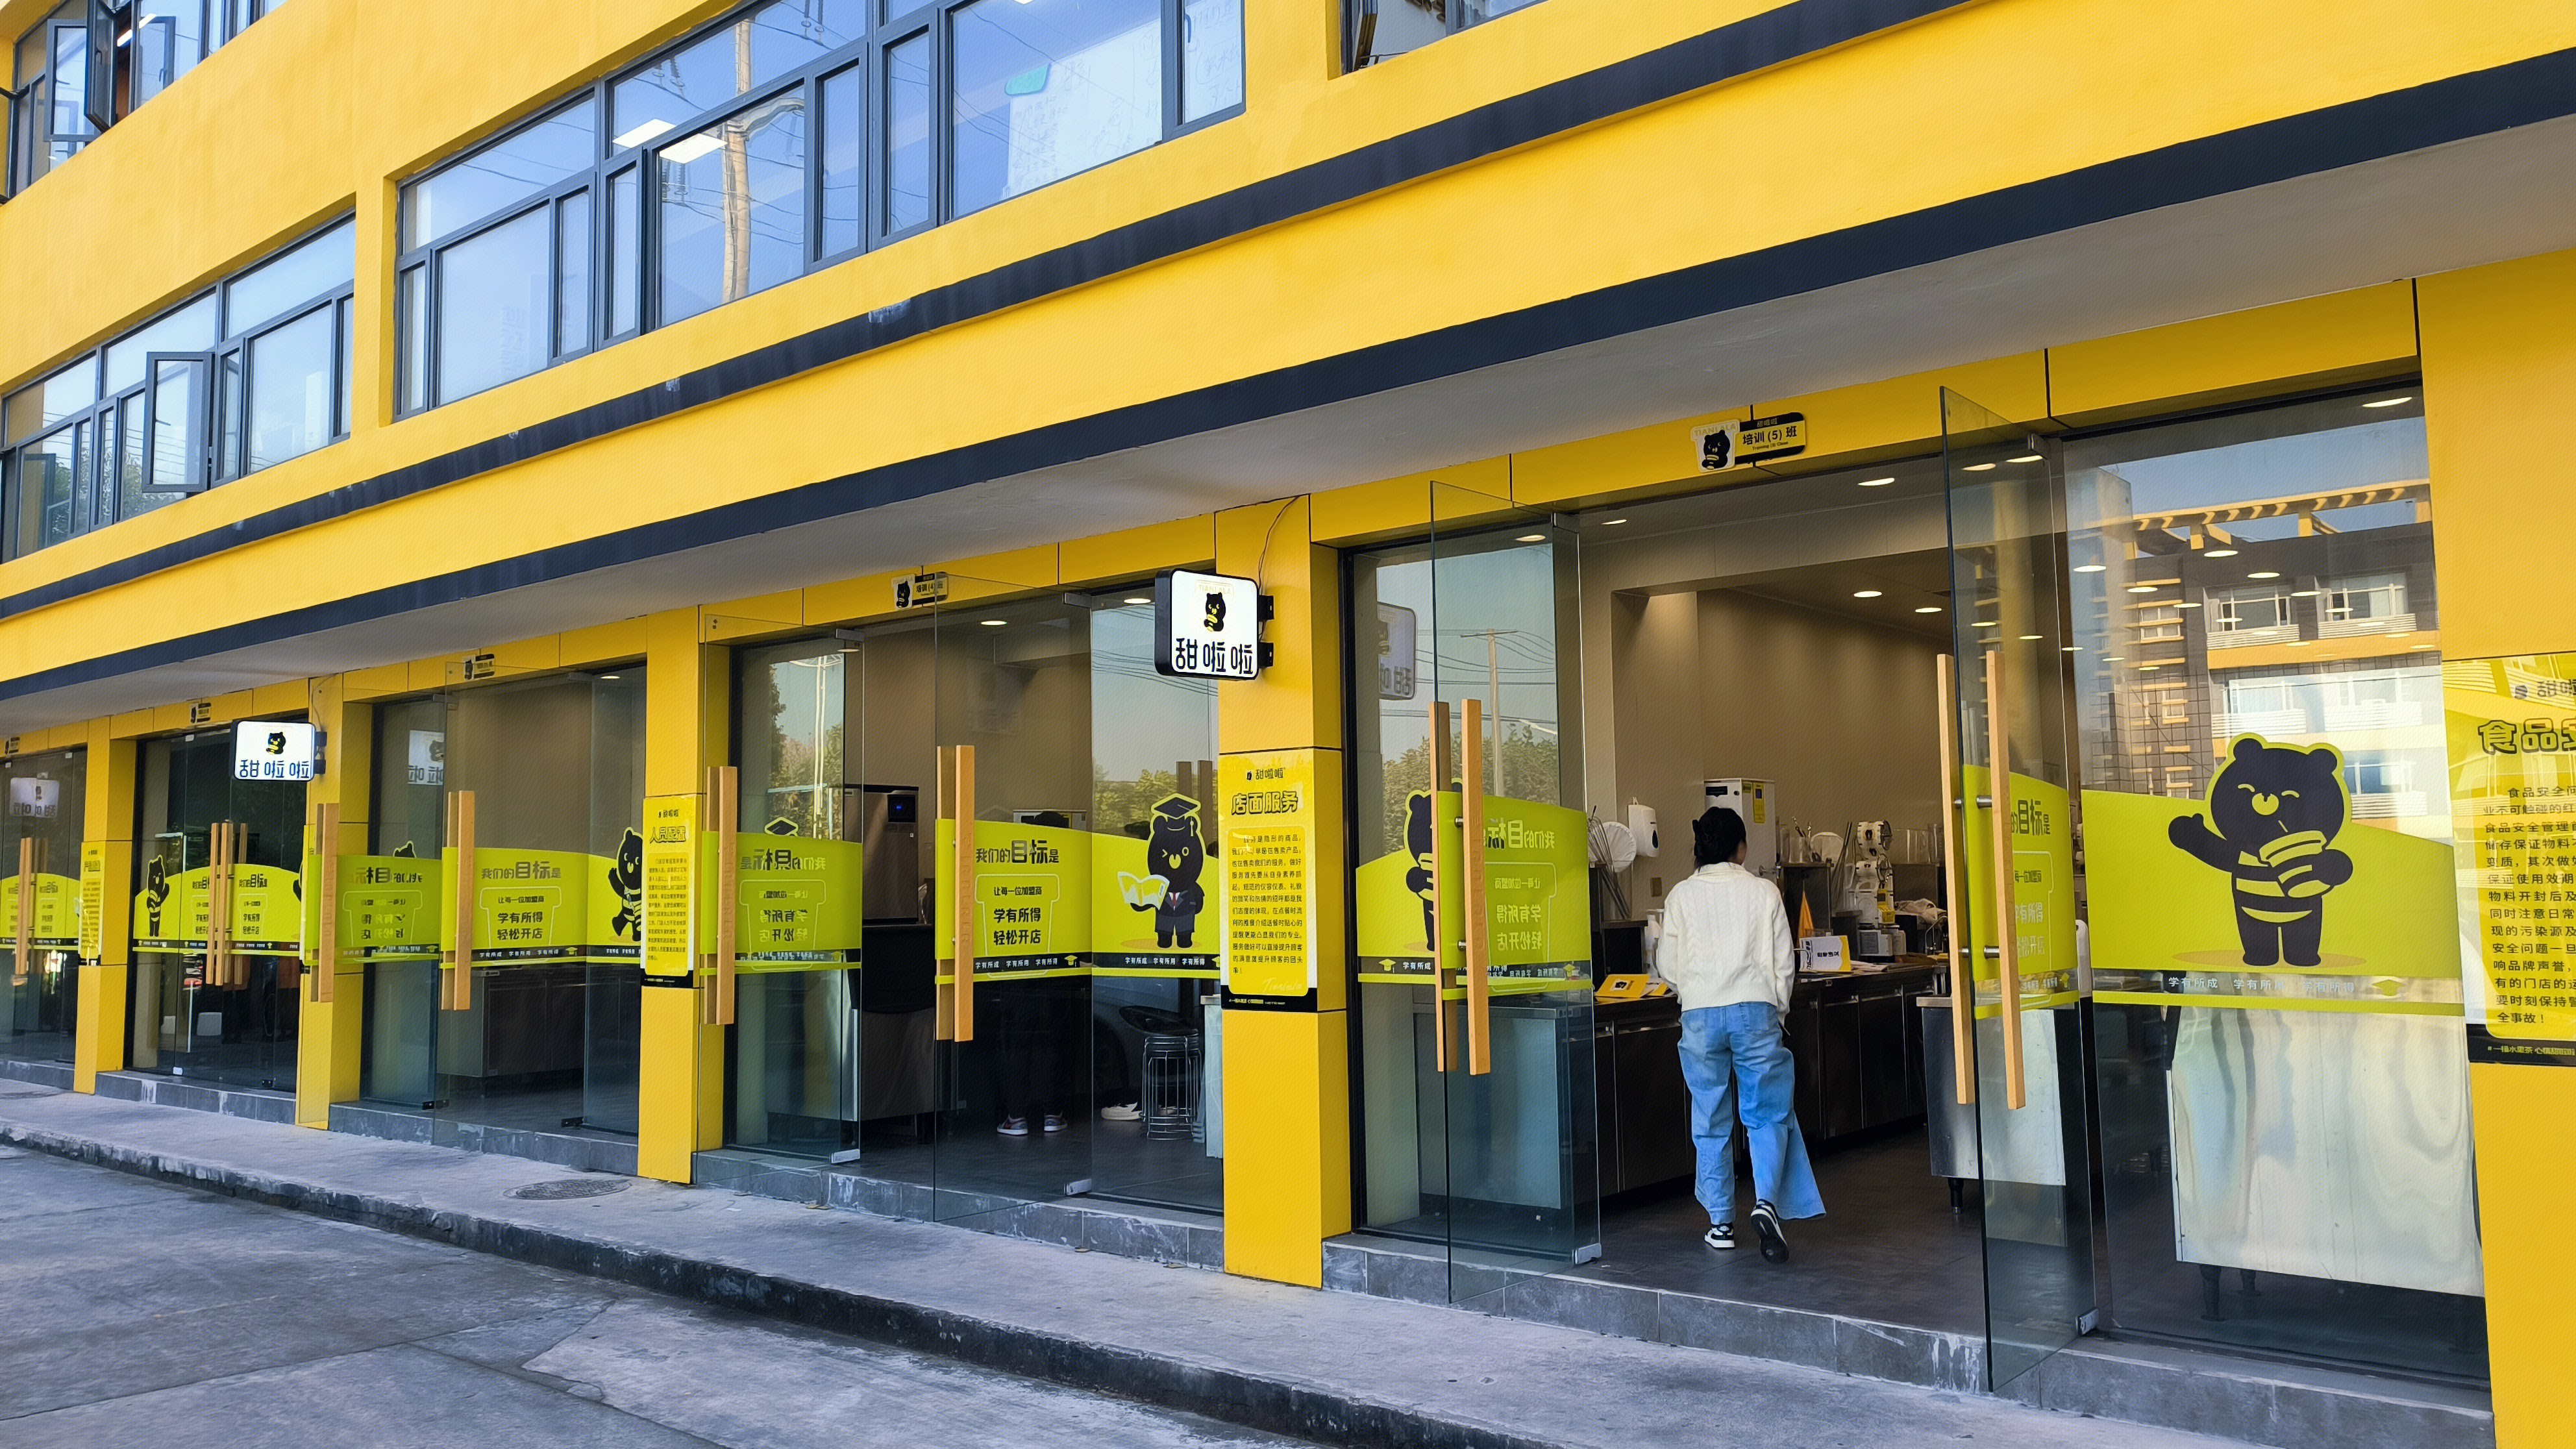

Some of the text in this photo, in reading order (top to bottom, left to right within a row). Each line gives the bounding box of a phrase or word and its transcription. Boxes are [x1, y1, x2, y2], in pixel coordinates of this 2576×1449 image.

[1176, 638, 1254, 675] 甜啦啦
[239, 759, 310, 778] 甜啦啦
[1256, 767, 1284, 780] 甜啦啦
[1231, 790, 1299, 816] 店面服务
[649, 826, 687, 844] 人员配置
[976, 839, 1059, 865] 我们的目标是
[481, 860, 562, 880] 我们的目标是
[994, 886, 1042, 897] 让每一位加盟商
[2488, 891, 2576, 902] 物料开封后及
[498, 895, 545, 904] 让每一位加盟商
[497, 911, 543, 924] 学有所得
[993, 908, 1041, 924] 学有所得
[2490, 908, 2575, 919] 同时注意日常
[497, 928, 543, 941] 轻松开店
[993, 929, 1041, 946] 轻松开店
[2491, 926, 2576, 937] 现的污染源及
[2492, 943, 2576, 954] 安全问题一旦
[1403, 961, 1431, 971] 学有所成
[2168, 976, 2218, 989] 学有所成
[2497, 1012, 2544, 1024] 全事故！
